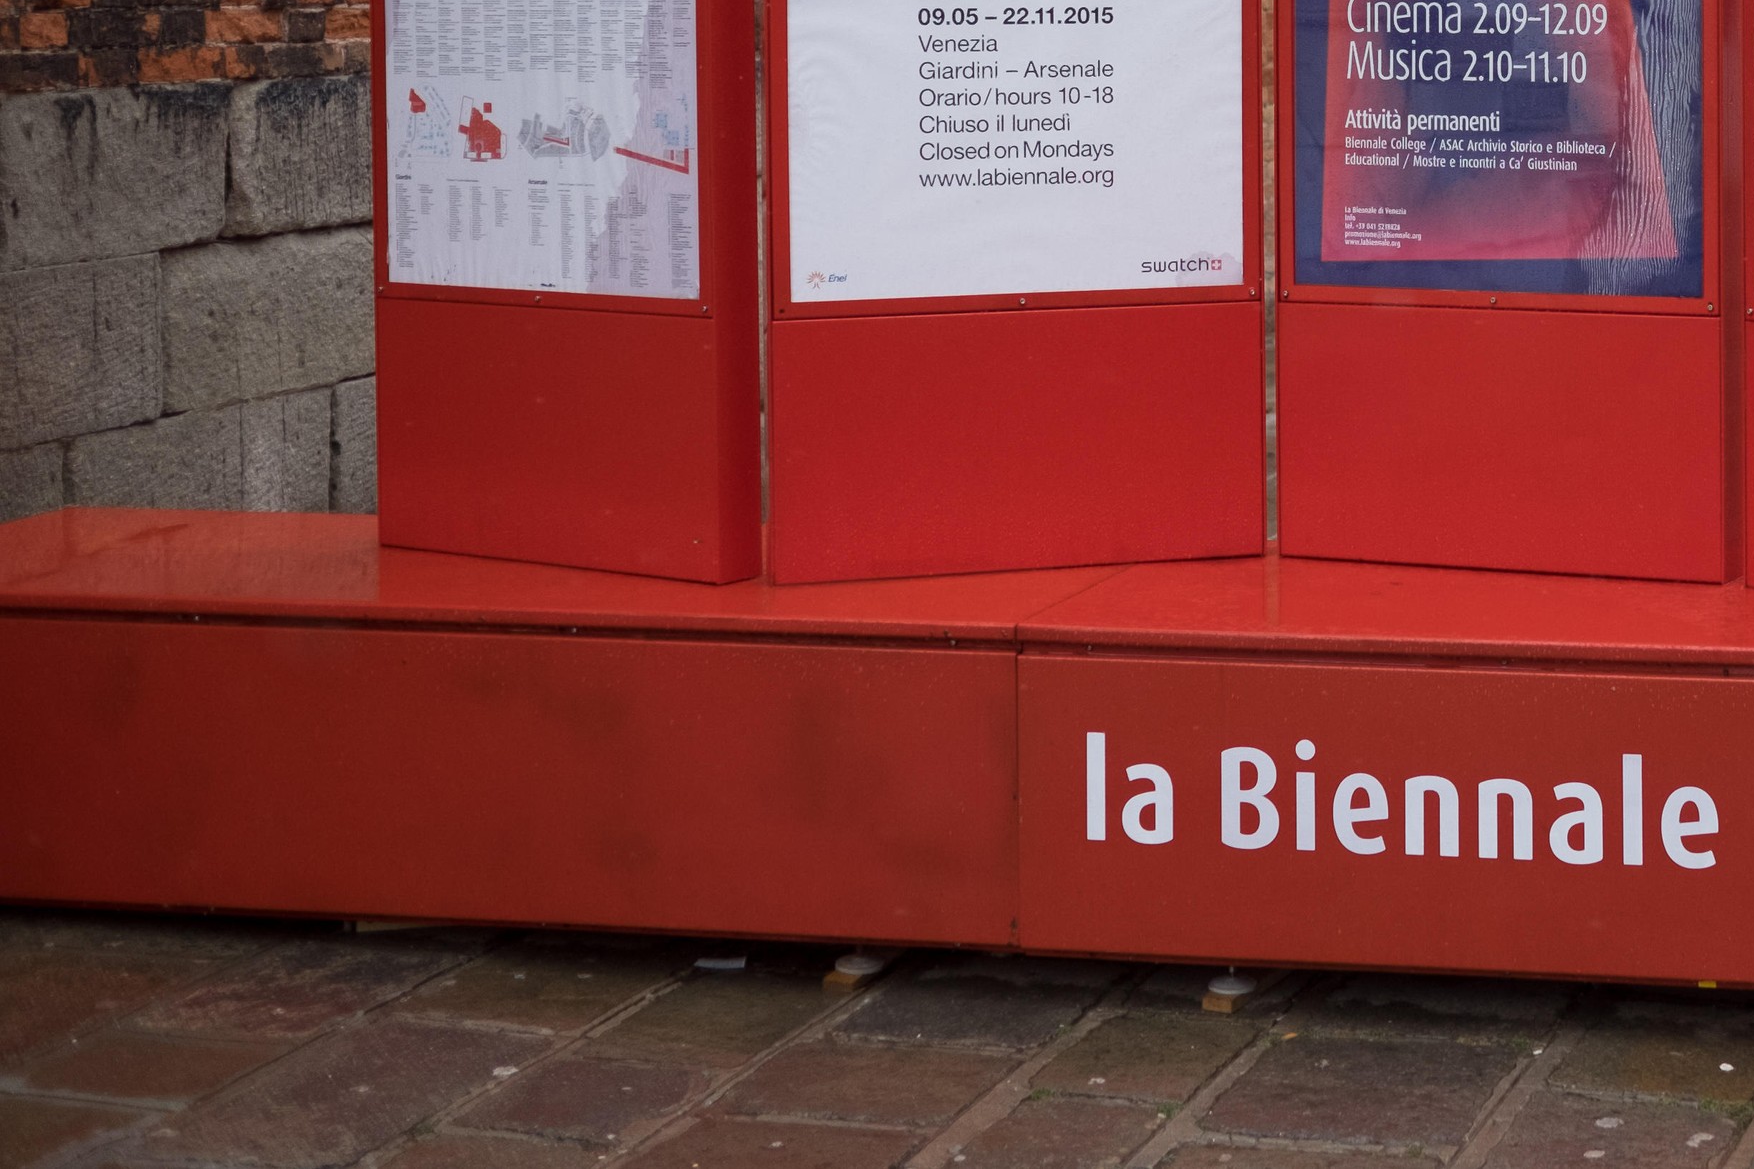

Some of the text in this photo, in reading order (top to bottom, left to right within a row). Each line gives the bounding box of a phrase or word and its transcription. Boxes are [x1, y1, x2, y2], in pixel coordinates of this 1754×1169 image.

[918, 6, 1114, 25] 09.05 22.11.2015
[918, 34, 998, 52] Venezia
[919, 60, 1114, 80] Giardini Arsenale
[1346, 38, 1452, 82] Musica
[919, 113, 1071, 133] Chiuso il lunedì
[1345, 108, 1500, 135] Attività permanenti
[919, 139, 1114, 162] Closed on Mondays
[1345, 136, 1606, 155] Biennale College ASAC Archivio Storico e Biblioteca
[1345, 152, 1400, 166] Educational
[1413, 155, 1446, 168] Mostre
[1449, 158, 1456, 168] e
[1459, 155, 1496, 169] incontri
[1499, 159, 1505, 169] a
[1527, 157, 1577, 171] Giustinian
[919, 167, 1114, 188] www.labiennale.org
[1141, 258, 1209, 273] swatch
[828, 274, 848, 283] Enel
[1086, 731, 1174, 845] la
[1220, 739, 1719, 869] Biennale
